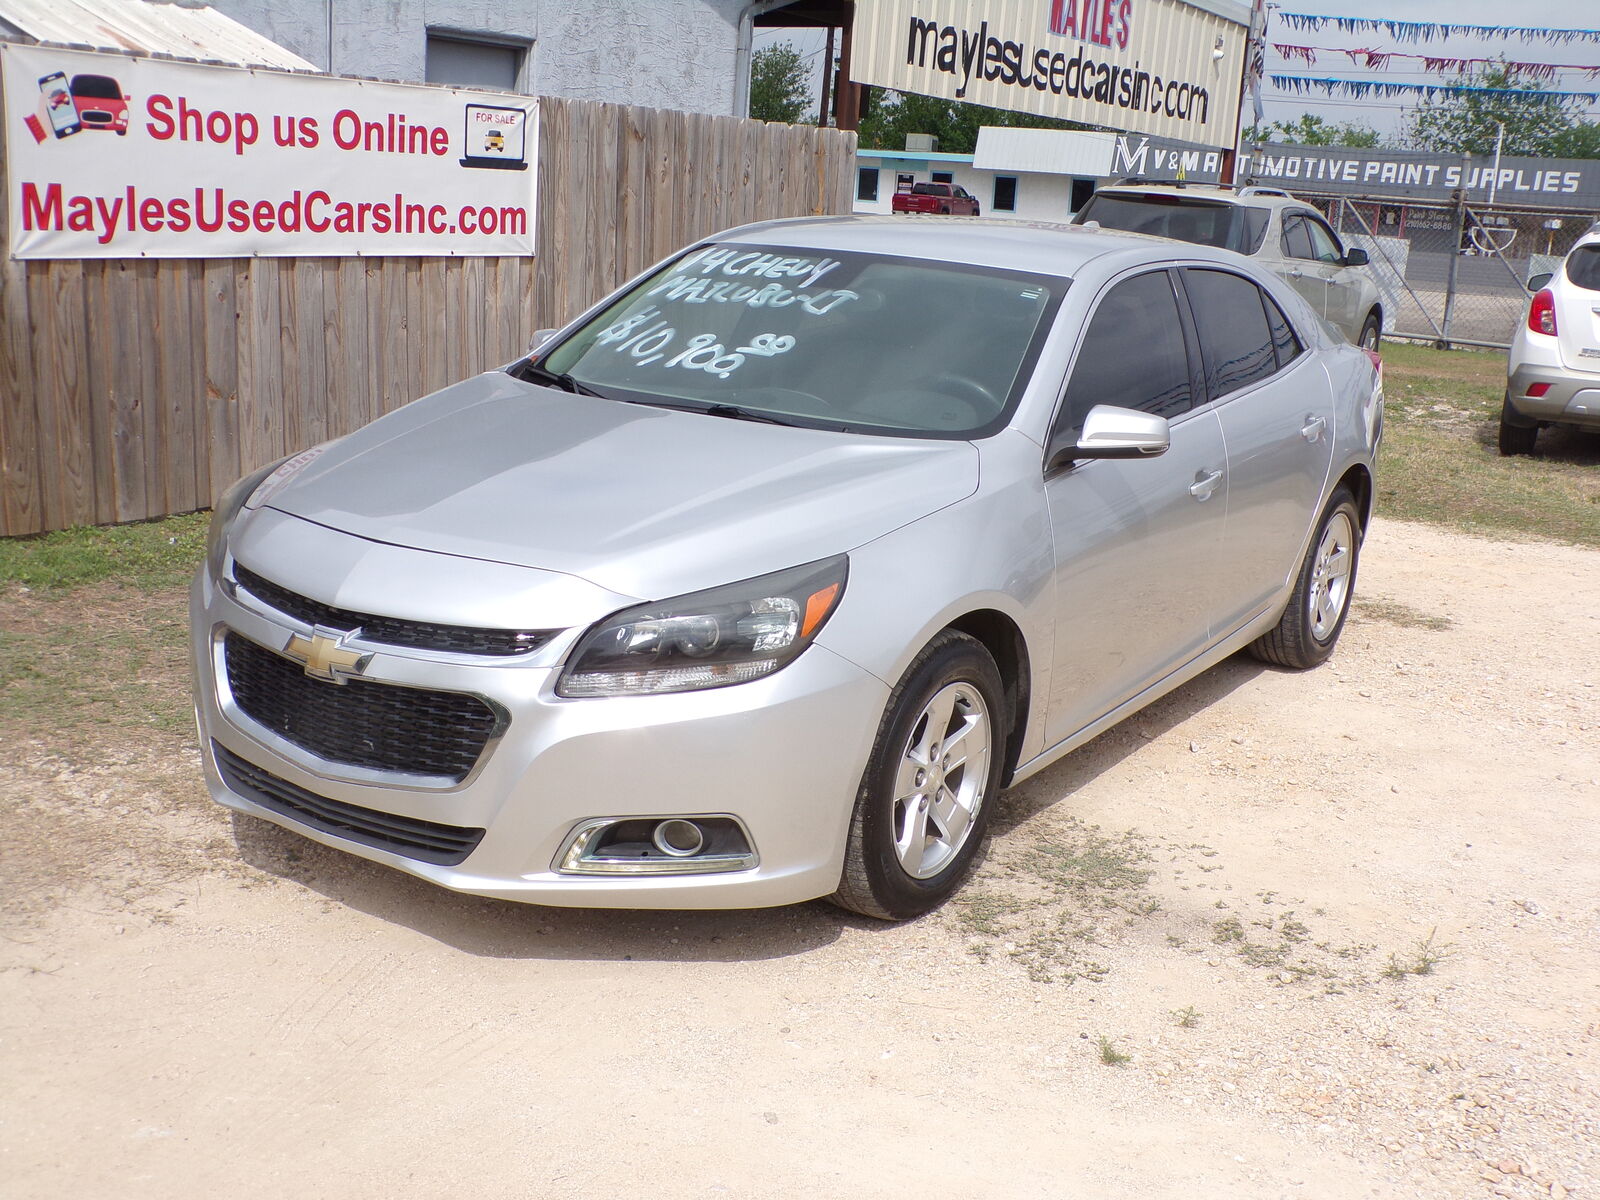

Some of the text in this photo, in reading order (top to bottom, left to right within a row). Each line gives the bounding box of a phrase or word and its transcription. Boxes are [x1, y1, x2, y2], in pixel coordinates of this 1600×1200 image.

[146, 93, 450, 157] Shop us Online
[476, 112, 516, 125] FOR SALE
[1154, 149, 1582, 193] V&M ATOMOTIVE PAINT SUPPLIES
[21, 181, 528, 244] MaylesUsedCarsInc.com
[722, 251, 842, 289] CHEVY
